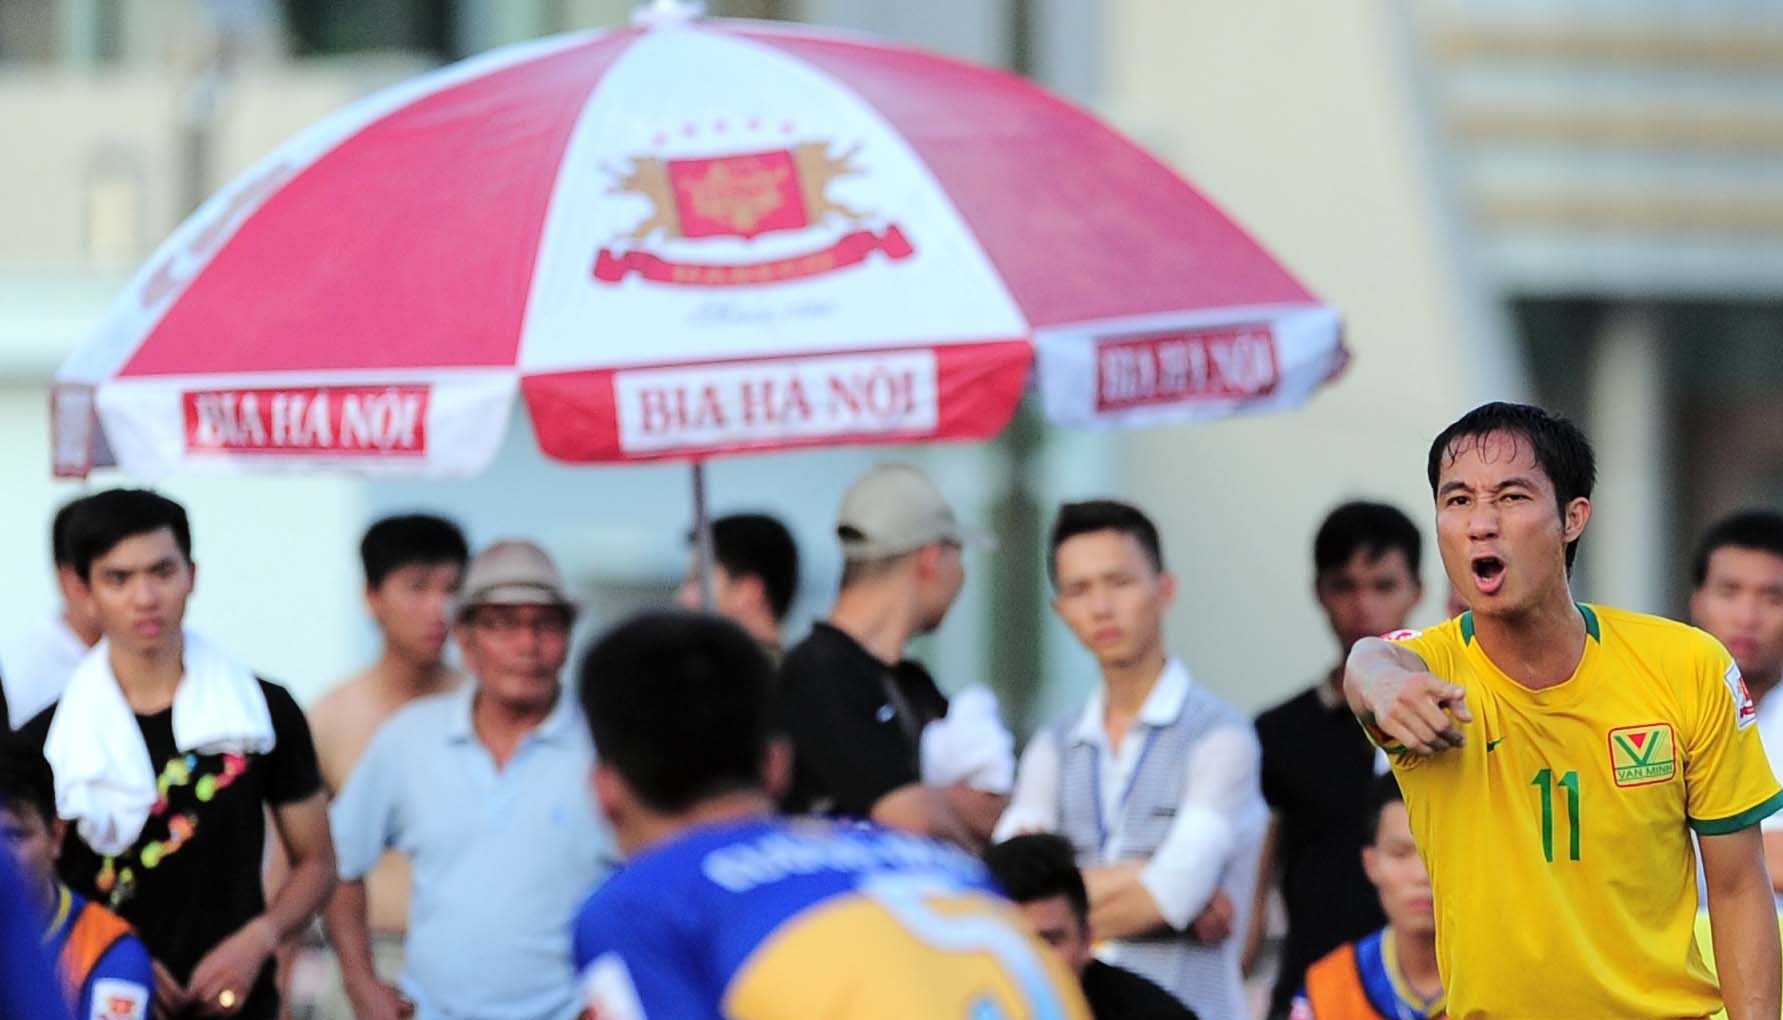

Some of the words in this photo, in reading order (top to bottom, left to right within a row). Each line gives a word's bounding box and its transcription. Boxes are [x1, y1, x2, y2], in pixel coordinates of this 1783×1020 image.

[637, 384, 726, 437] BIA
[826, 362, 916, 420] NỘI
[1531, 768, 1580, 862] 11
